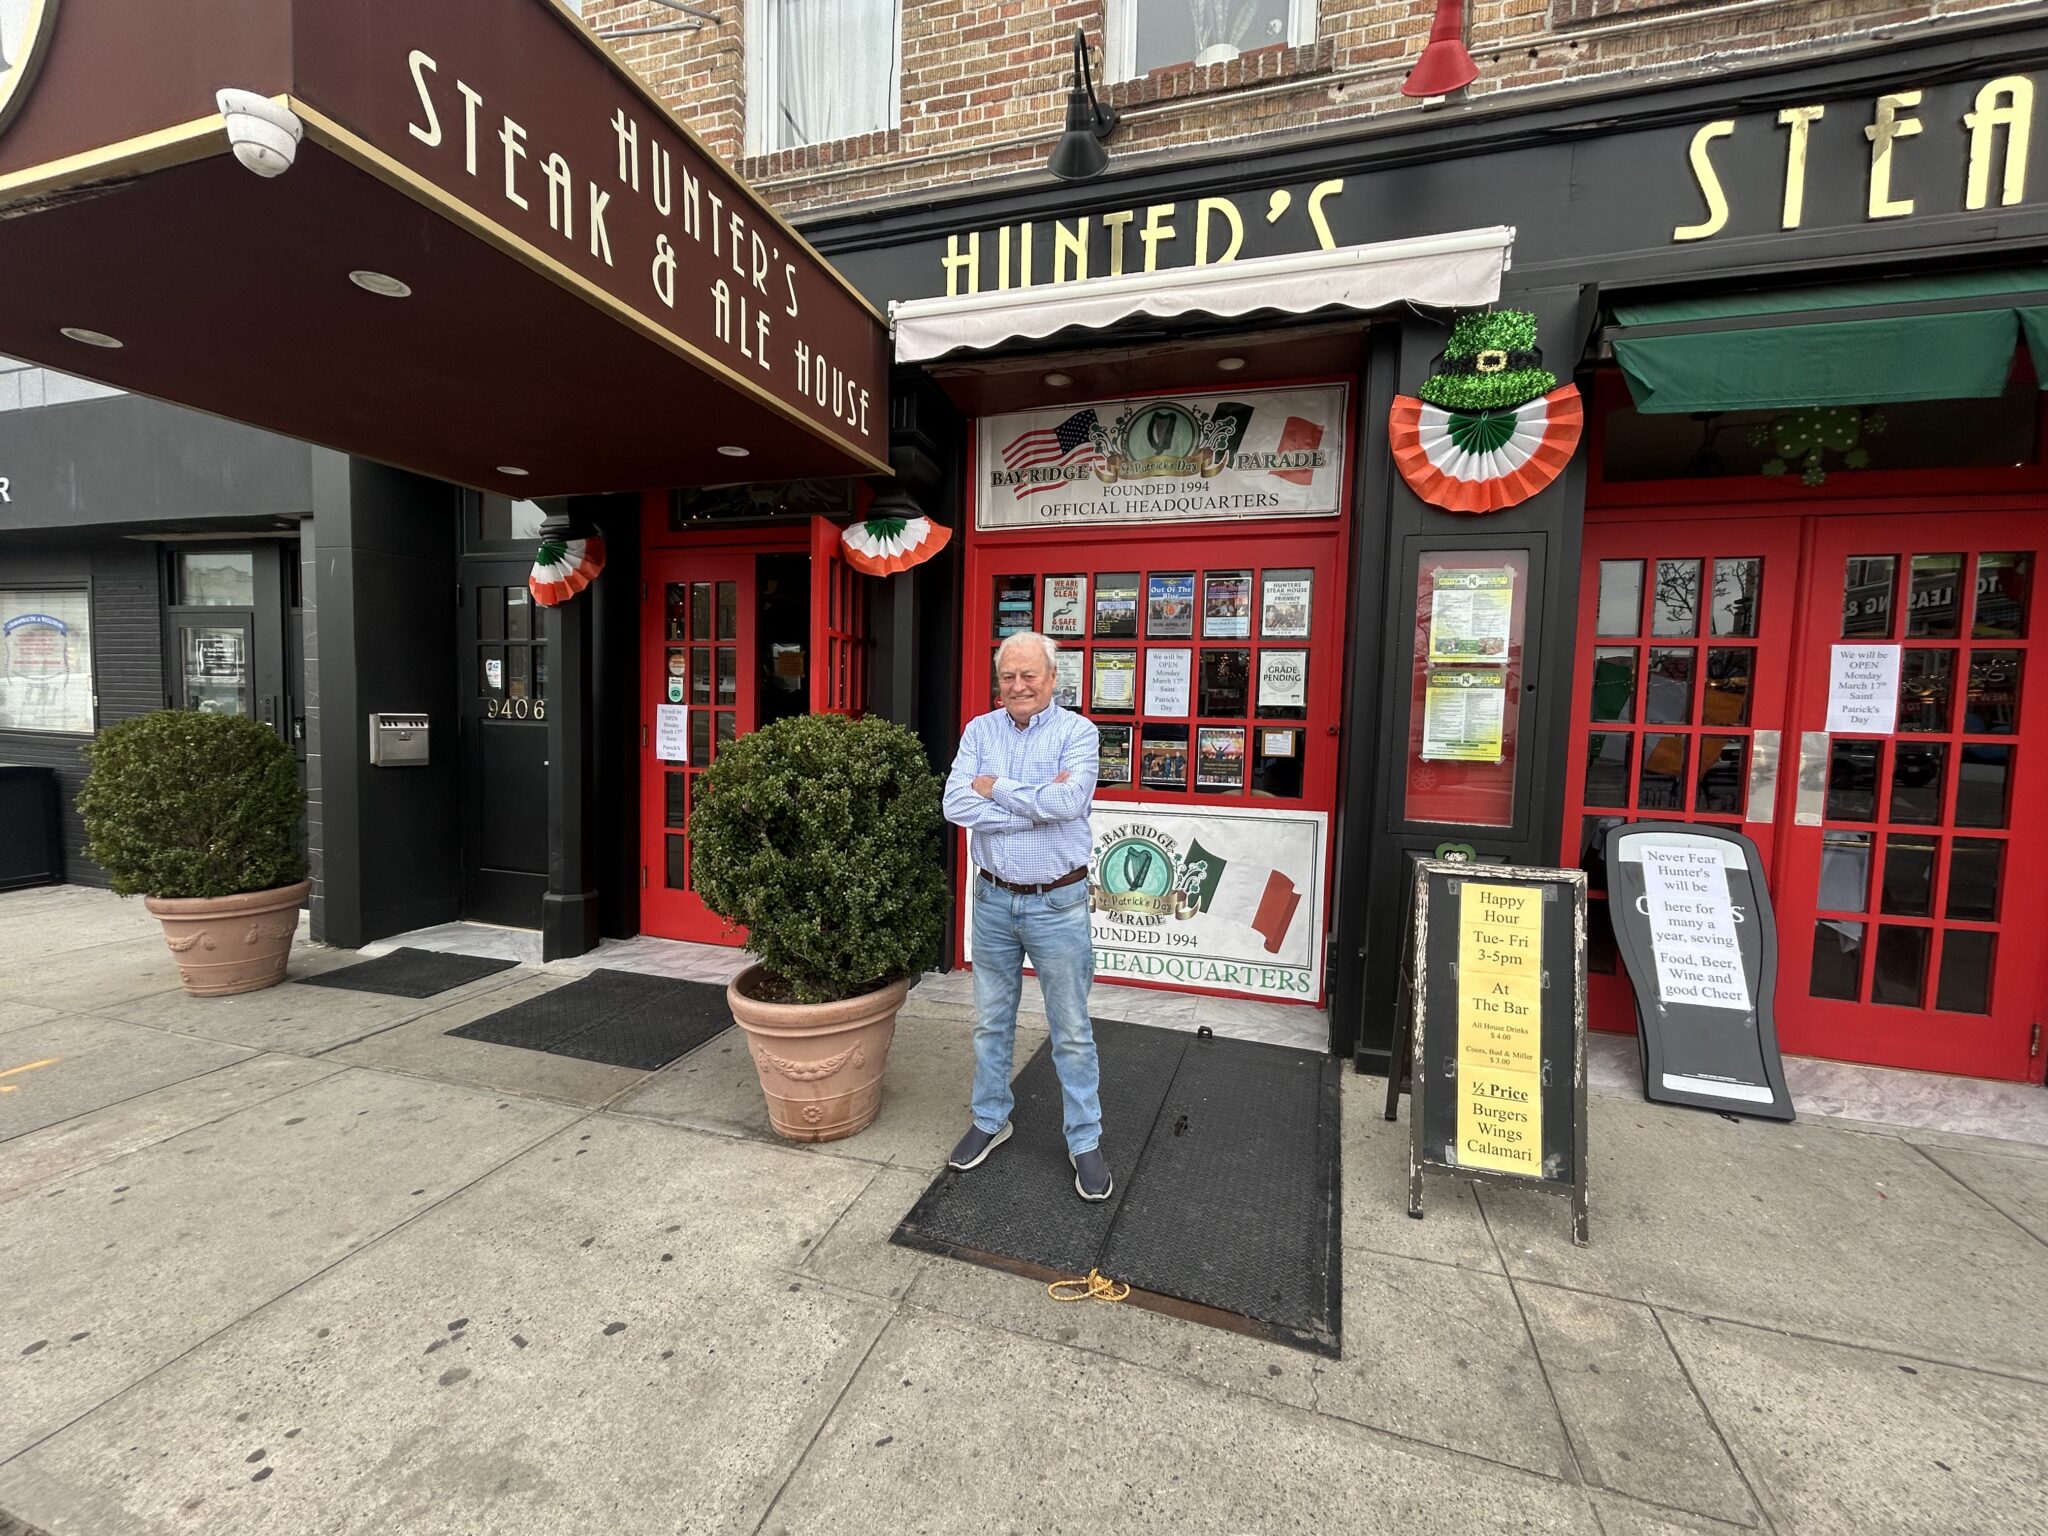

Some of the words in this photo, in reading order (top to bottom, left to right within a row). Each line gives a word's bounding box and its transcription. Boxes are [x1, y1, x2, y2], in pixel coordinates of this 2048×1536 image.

[1673, 75, 2034, 241] STEA
[610, 107, 798, 318] HUNTER'S
[408, 49, 614, 267] STEAK
[651, 233, 677, 309] &
[710, 278, 771, 371] ALE
[794, 339, 869, 436] HOUSE
[1134, 461, 1174, 473] Patrick's
[1177, 460, 1197, 473] Day
[1235, 451, 1325, 470] PARADE
[991, 470, 1025, 487] BAY
[1029, 464, 1089, 482] RIDGE
[1103, 483, 1176, 497] FOUNDED
[1181, 481, 1210, 493] 1994
[1040, 501, 1120, 517] OFFICIAL
[1126, 493, 1279, 514] HEADQUARTERS
[1178, 585, 1192, 593] The
[1058, 618, 1077, 626] SAFE
[1065, 624, 1077, 632] ALL
[1840, 651, 1855, 659] We
[1857, 651, 1875, 659] will
[1877, 651, 1888, 659] be
[1267, 665, 1297, 674] GRADE
[1849, 661, 1879, 670] OPEN
[1156, 670, 1180, 678] Monday
[1263, 674, 1301, 682] PENDING
[1844, 672, 1882, 681] Monday
[1838, 682, 1867, 690] March
[1849, 692, 1873, 700] Saint
[487, 699, 545, 720] 9406
[1160, 704, 1173, 712] Day
[1842, 705, 1880, 714] Patrick's
[1851, 716, 1869, 725] Day
[1101, 825, 1129, 846] BAY
[1131, 824, 1178, 854] RIDGE
[1647, 850, 1685, 862] Never
[1688, 853, 1717, 864] Fear
[1658, 865, 1711, 878] Hunter's
[1664, 880, 1688, 891] will
[1692, 881, 1708, 892] be
[1112, 896, 1151, 907] Patrick's
[1153, 899, 1172, 913] Day
[1479, 891, 1525, 909] Happy
[1664, 900, 1692, 913] here
[1695, 903, 1715, 914] for
[1108, 910, 1166, 926] PARADE
[1484, 910, 1520, 925] Hour
[1668, 918, 1703, 931] many
[1707, 921, 1715, 929] a
[1166, 933, 1198, 948] 1994
[1473, 930, 1504, 945] Tue-
[1509, 934, 1529, 948] Fri
[1656, 931, 1687, 943] year,
[1690, 933, 1734, 948] seving
[1477, 949, 1523, 966] 3-5pm
[1660, 952, 1697, 967] Food,
[1701, 955, 1737, 970] Beer,
[1092, 952, 1311, 993] HEADQUARTERS
[1668, 968, 1704, 982] Wine
[1707, 973, 1732, 984] and
[1492, 982, 1510, 995] At
[1665, 985, 1698, 997] good
[1701, 986, 1742, 1001] Cheer
[1472, 997, 1500, 1013] The
[1504, 1001, 1529, 1016] Bar
[1472, 1021, 1483, 1030] All
[1484, 1023, 1505, 1032] House
[1506, 1025, 1529, 1035] Drinks
[1496, 1033, 1512, 1041] 4.00
[1465, 1045, 1487, 1056] Coors,
[1489, 1047, 1503, 1056] Bud
[1504, 1048, 1510, 1057] &
[1512, 1050, 1533, 1061] Miller
[1490, 1084, 1529, 1101] Price
[1472, 1102, 1528, 1123] Burgers
[1477, 1121, 1523, 1143] Wings
[1467, 1139, 1532, 1162] Calamari
